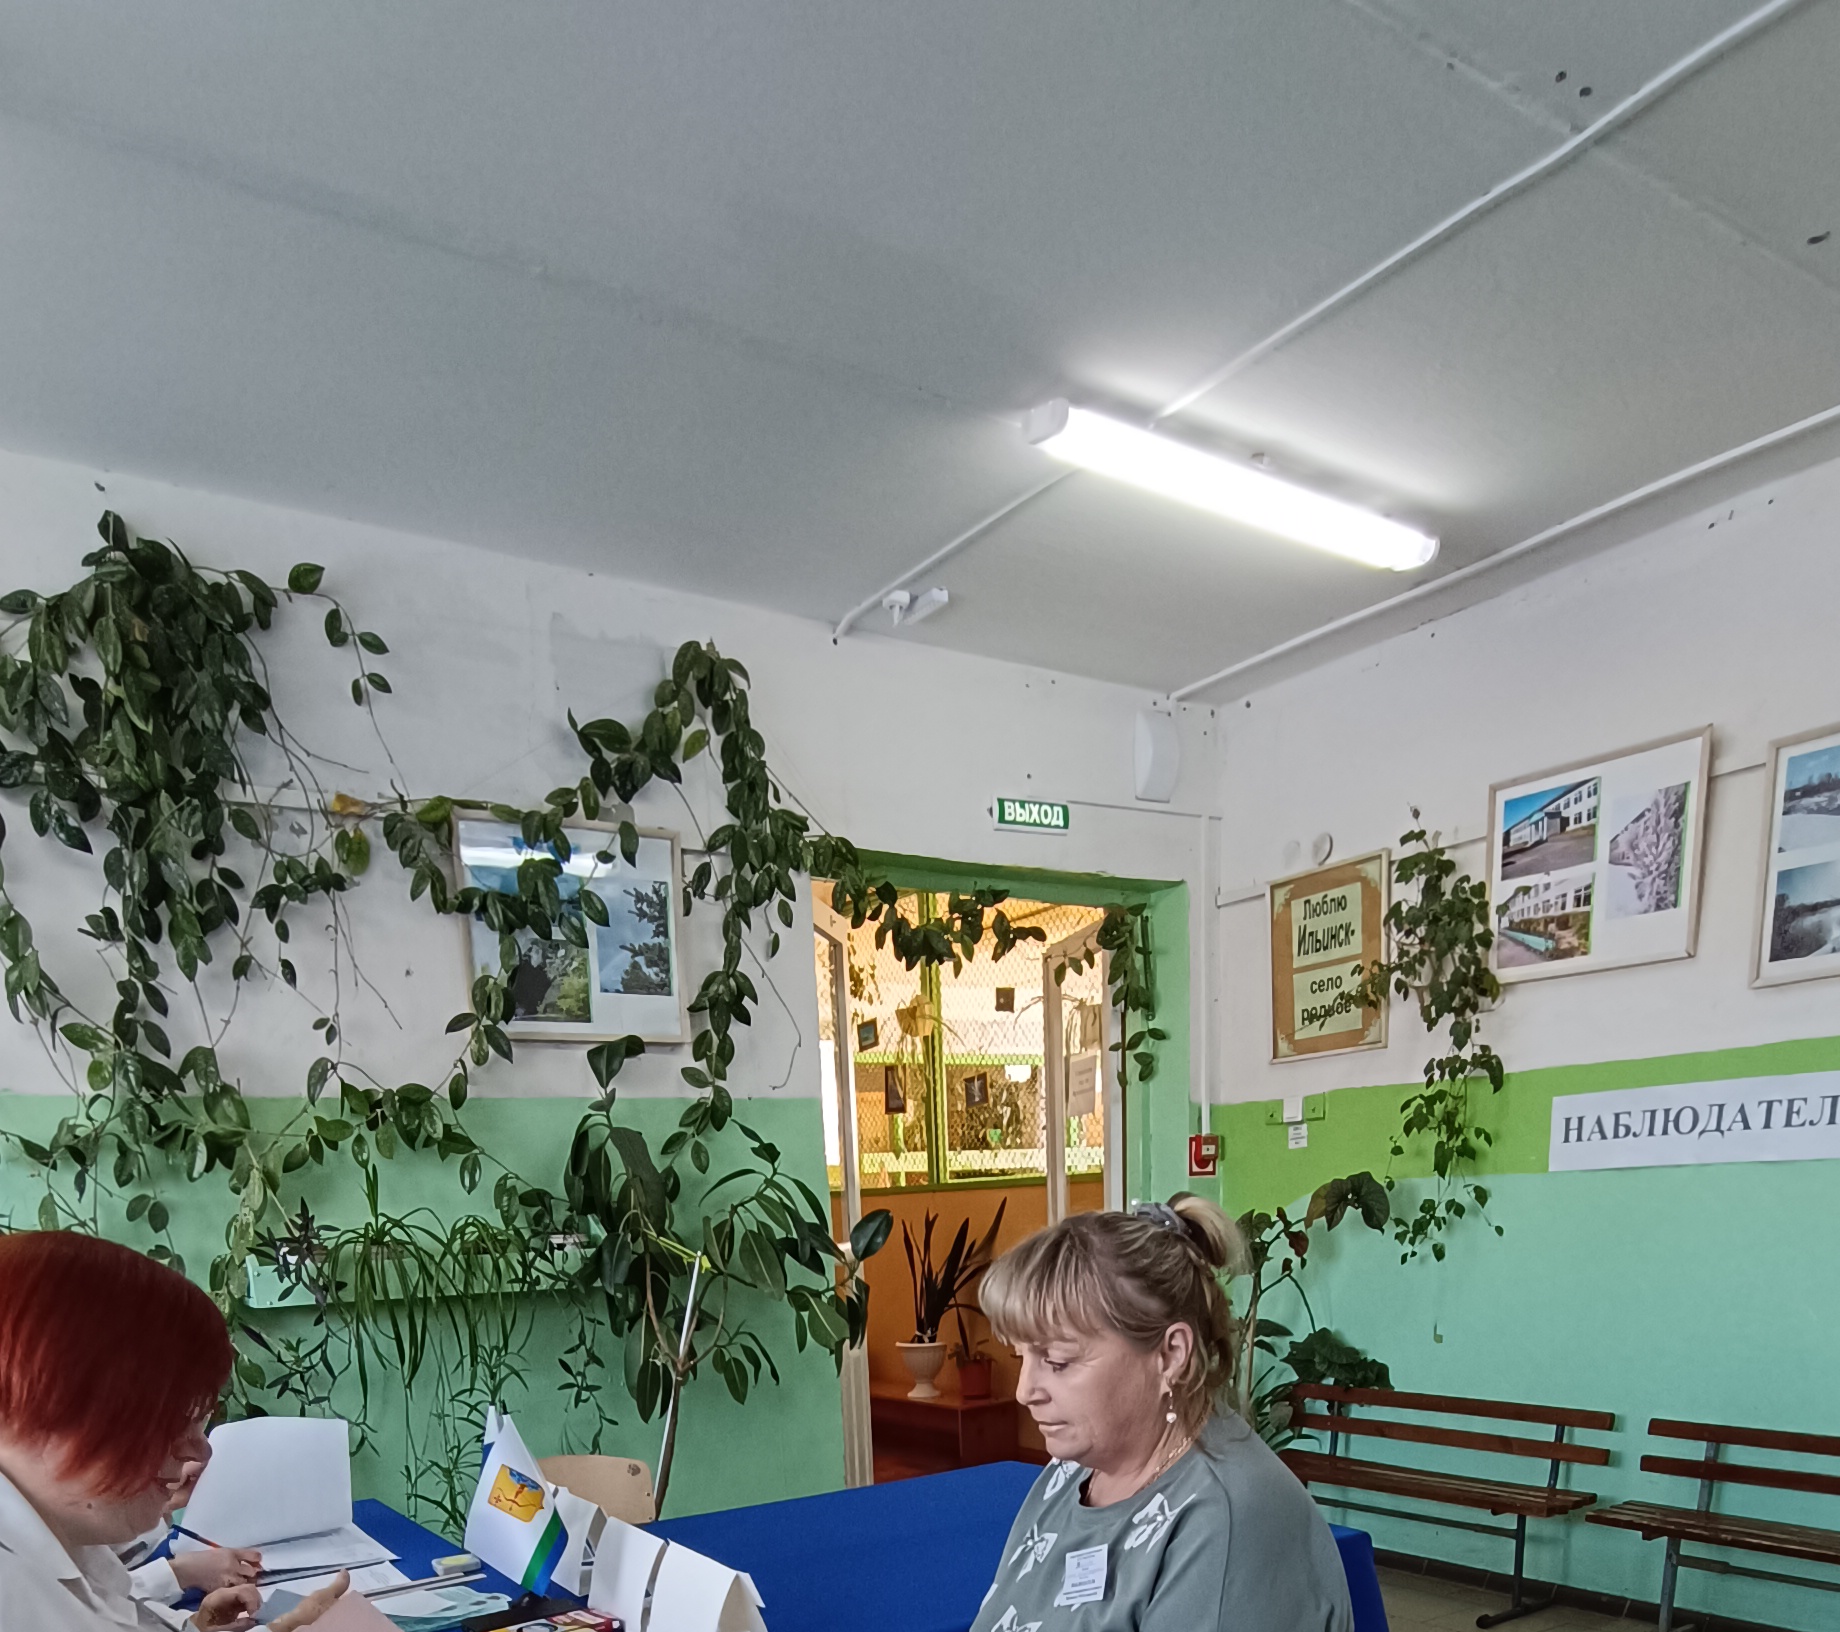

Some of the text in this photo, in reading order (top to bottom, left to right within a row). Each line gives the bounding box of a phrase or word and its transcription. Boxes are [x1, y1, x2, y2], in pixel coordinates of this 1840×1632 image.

[1003, 801, 1064, 827] ВЫХОД
[1303, 893, 1347, 921] Люблю
[1310, 975, 1343, 995] село
[1562, 1095, 1840, 1144] НАБЛЮДАТЕЛ
